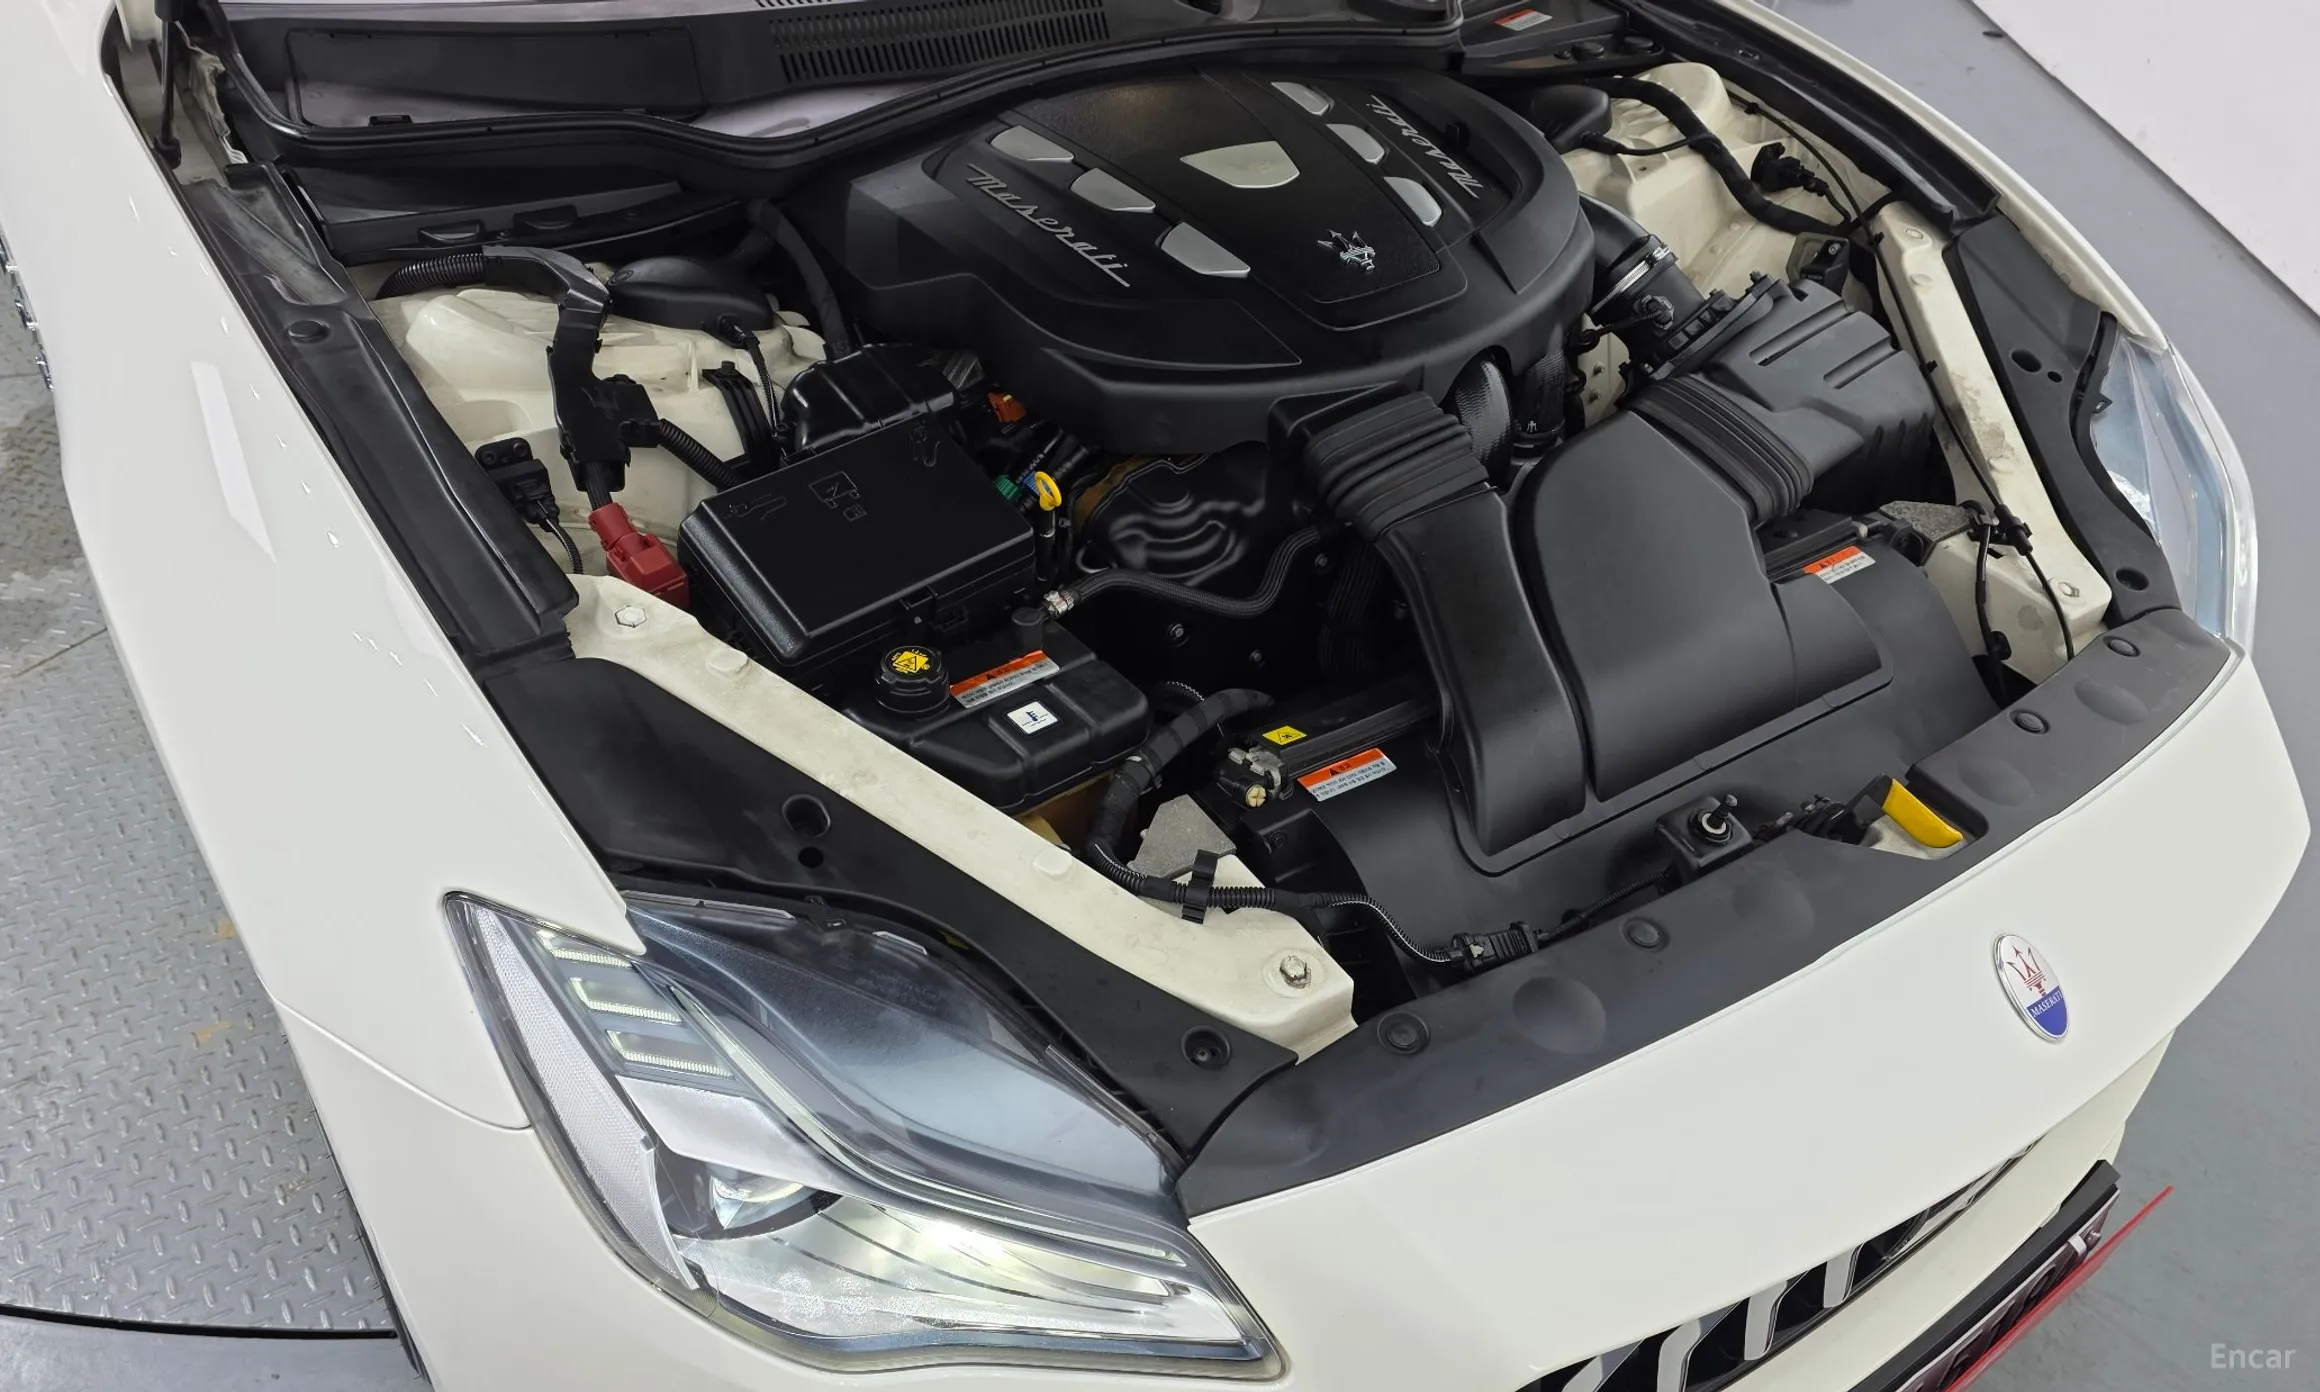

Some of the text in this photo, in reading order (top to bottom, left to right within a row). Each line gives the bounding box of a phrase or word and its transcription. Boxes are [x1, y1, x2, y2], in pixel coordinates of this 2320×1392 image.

[1366, 94, 1484, 199] Maserati
[965, 163, 1130, 288] Maserati
[2030, 990, 2064, 1018] MASERATI
